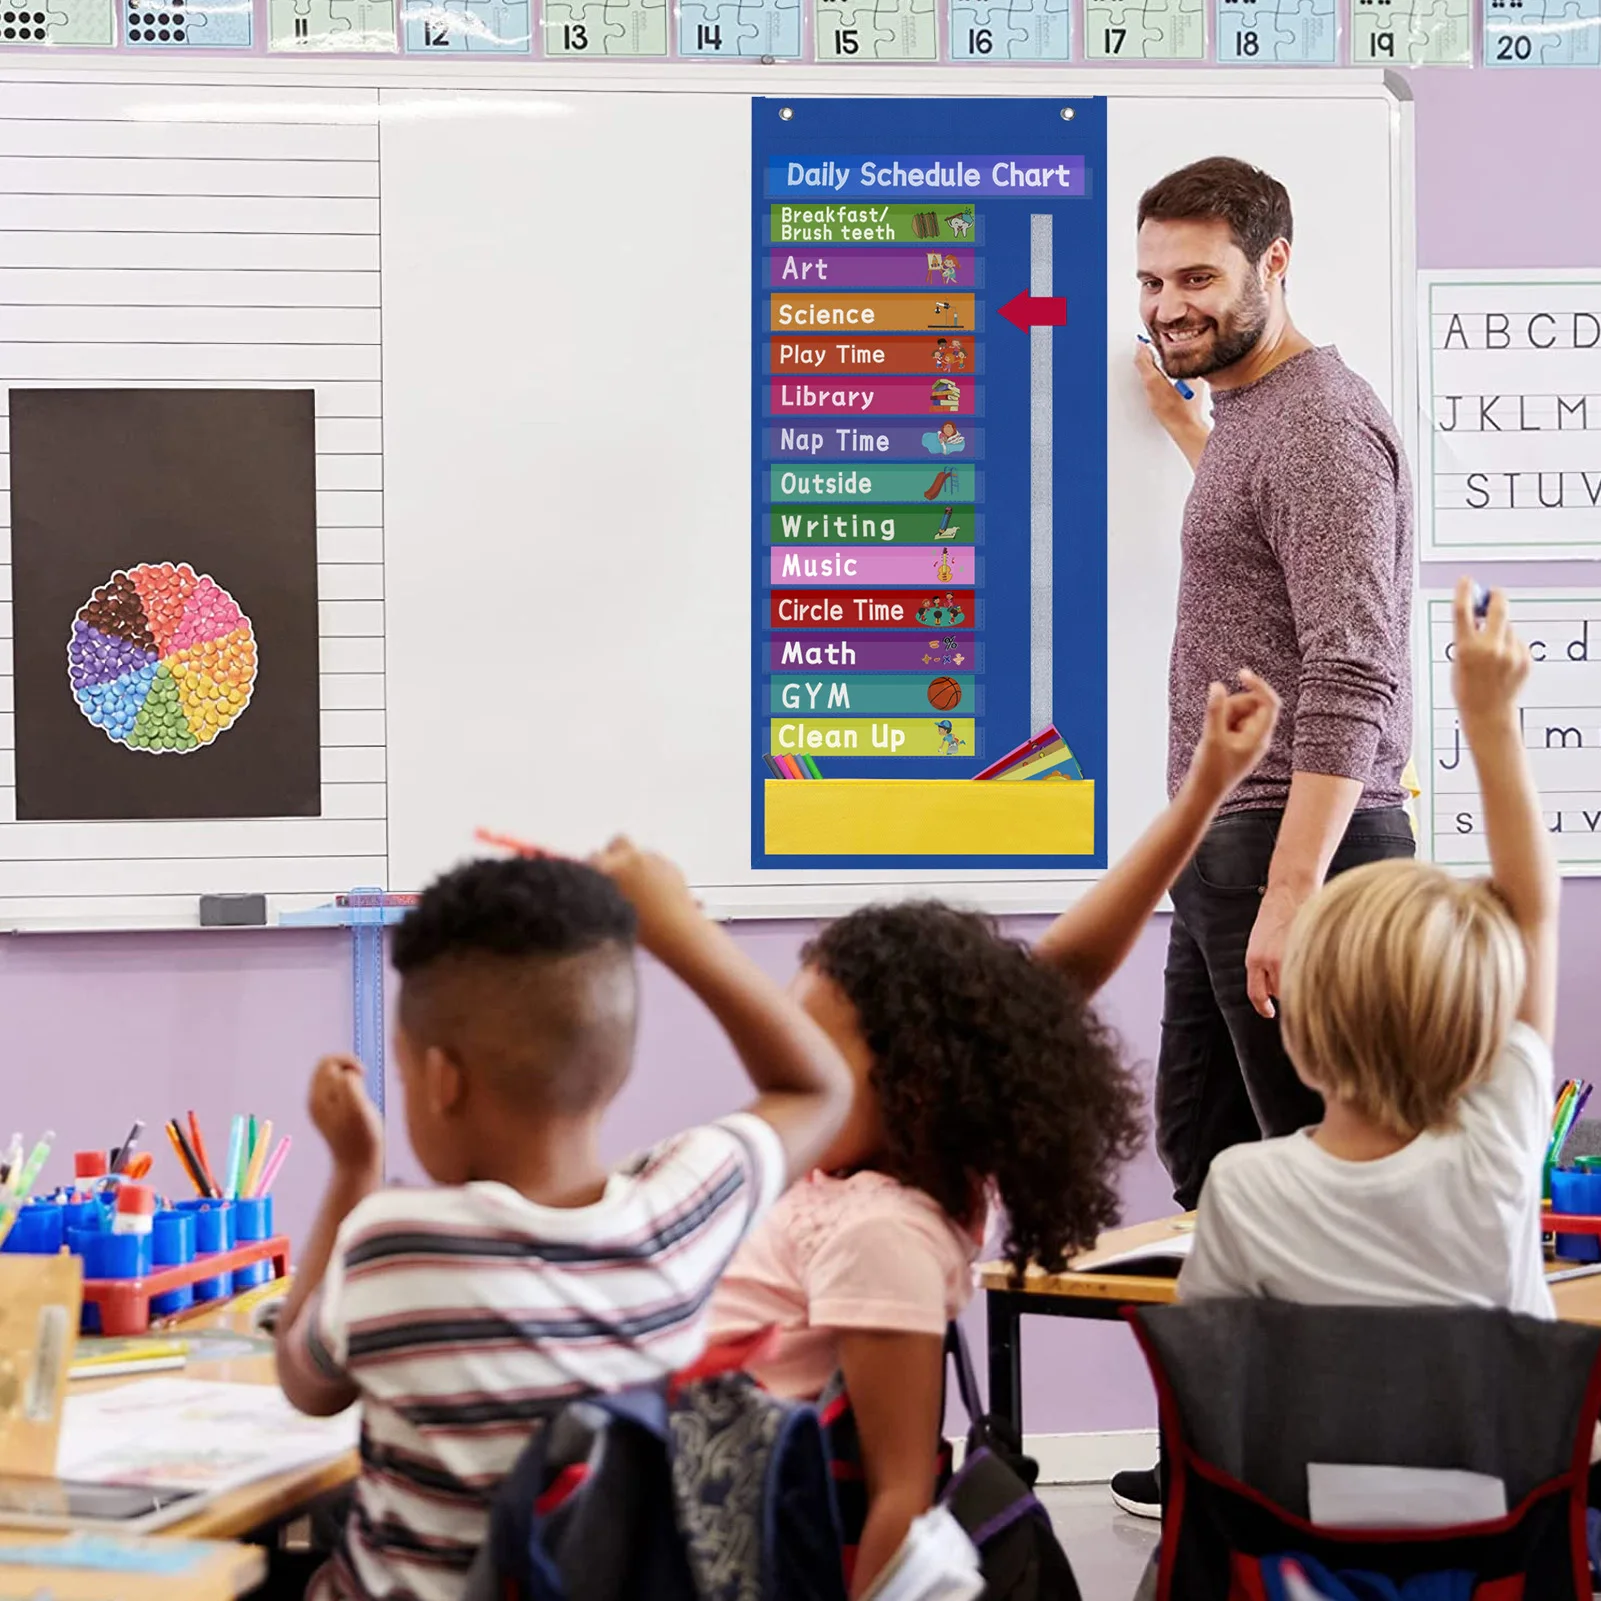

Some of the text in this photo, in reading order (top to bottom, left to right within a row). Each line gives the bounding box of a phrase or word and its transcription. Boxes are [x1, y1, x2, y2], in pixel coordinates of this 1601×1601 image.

[564, 24, 588, 50] 13
[698, 24, 722, 50] 14
[835, 30, 859, 55] 15
[969, 28, 993, 55] 16
[1105, 28, 1127, 54] 17
[1236, 31, 1259, 56] 18
[1371, 32, 1394, 58] 19
[1497, 36, 1532, 60] 20
[787, 161, 1070, 191] Daily Schedule Chart
[781, 206, 890, 223] Breakfast/
[781, 223, 895, 241] Brush teeth
[781, 255, 828, 280] Art
[779, 303, 875, 325] Science
[1444, 313, 1600, 349] A B C D
[780, 344, 885, 367] Play Time
[781, 384, 875, 411] Library
[1439, 396, 1586, 431] J K L M
[780, 428, 890, 455] Nap Time
[781, 471, 872, 495] Outside
[1466, 474, 1490, 508] S
[1504, 473, 1520, 508] T
[1581, 472, 1601, 505] V
[781, 514, 895, 541] Writing
[781, 552, 857, 578] Music
[778, 598, 904, 621] Circle Time
[781, 640, 856, 665] Math
[1530, 620, 1587, 661] c d
[781, 682, 851, 710] GYM
[778, 723, 906, 753] Clean Up
[1439, 719, 1460, 770] j
[1545, 727, 1582, 748] m
[1456, 812, 1473, 833] s
